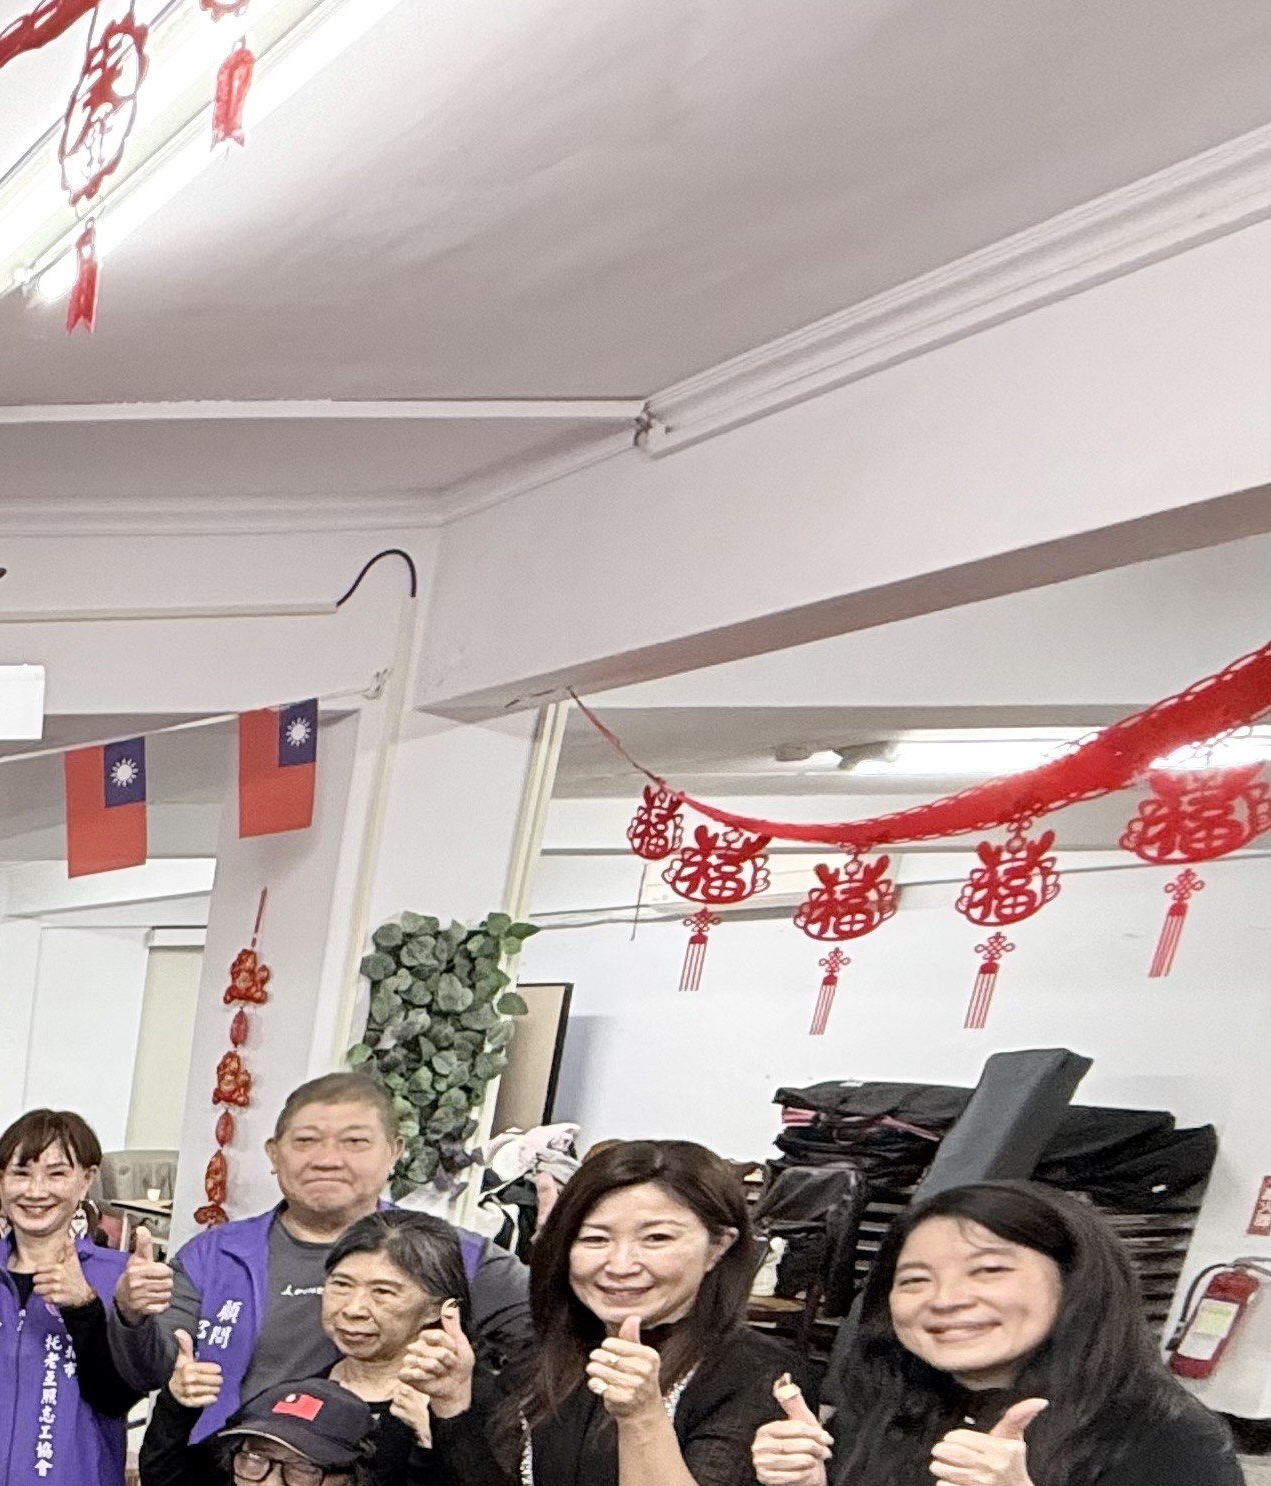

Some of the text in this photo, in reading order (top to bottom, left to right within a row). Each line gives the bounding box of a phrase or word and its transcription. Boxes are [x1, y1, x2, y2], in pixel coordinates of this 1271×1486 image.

[674, 825, 772, 904] 福
[804, 854, 889, 941] 福
[967, 830, 1055, 926] 福
[208, 1299, 243, 1349] 顧問
[34, 1333, 63, 1477] 托老互照志工協會
